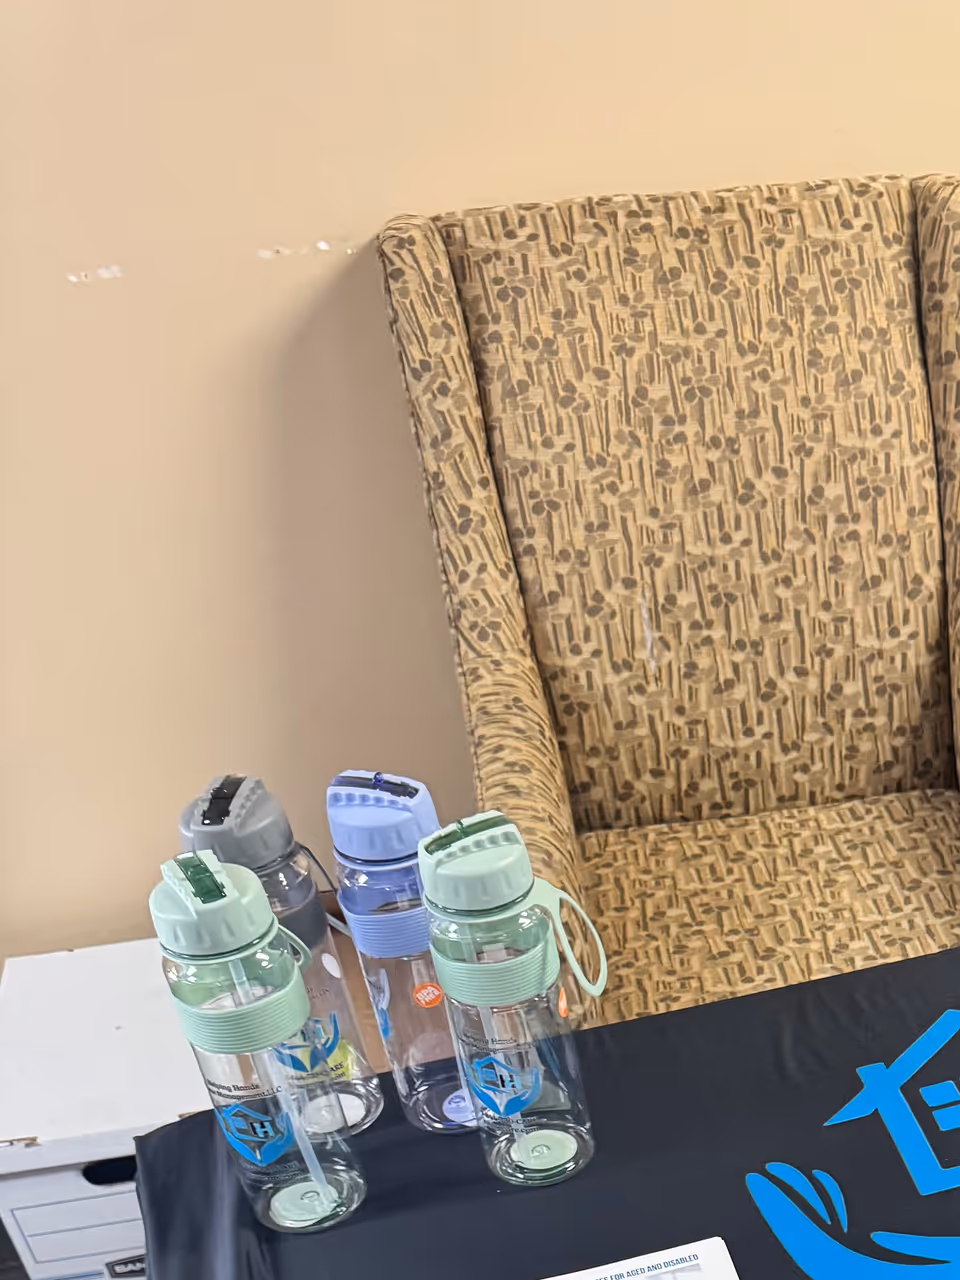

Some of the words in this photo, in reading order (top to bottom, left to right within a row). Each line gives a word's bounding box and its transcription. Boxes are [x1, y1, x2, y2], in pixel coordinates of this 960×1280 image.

[626, 1267, 646, 1278] AGED
[647, 1263, 663, 1272] AND
[663, 1254, 699, 1268] DISABLED
